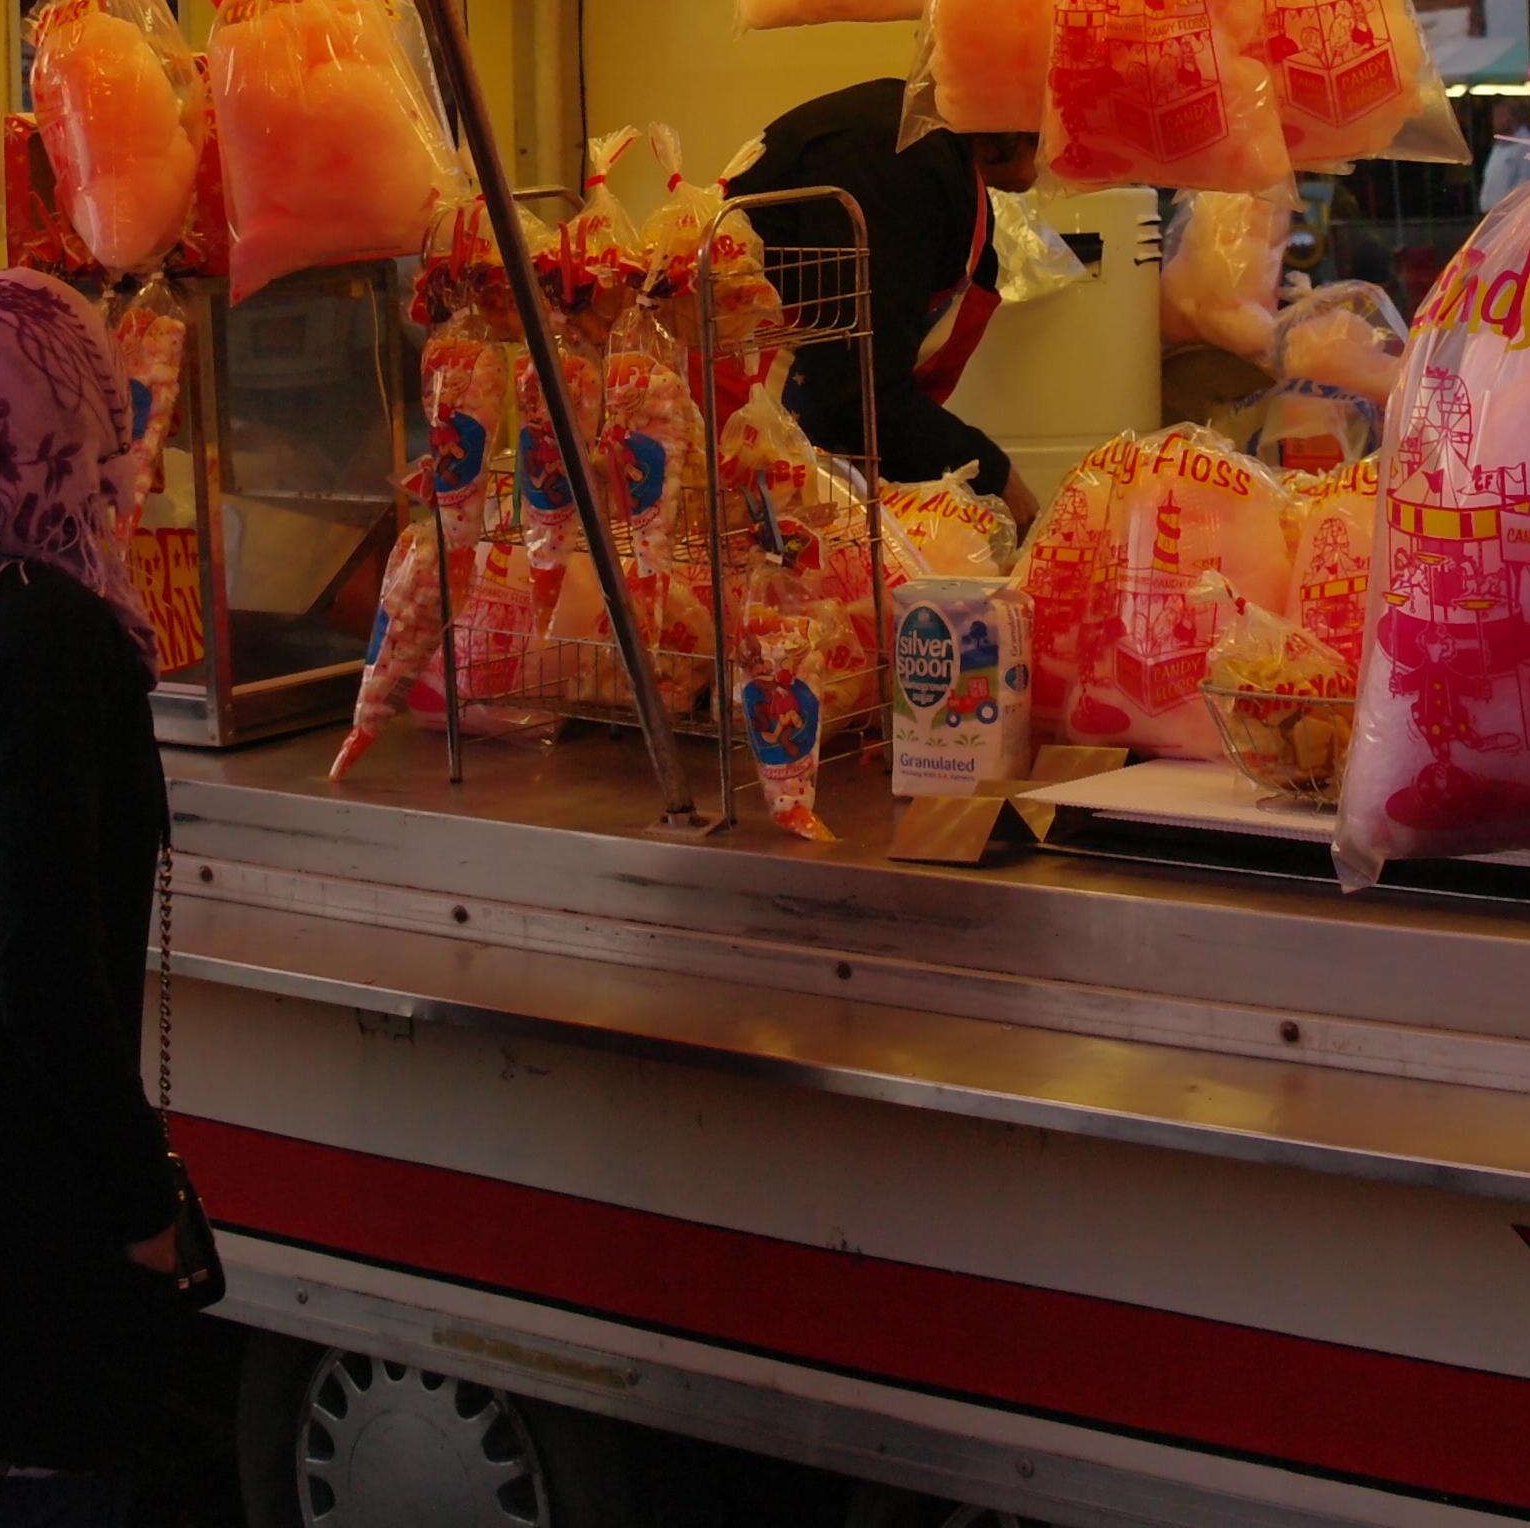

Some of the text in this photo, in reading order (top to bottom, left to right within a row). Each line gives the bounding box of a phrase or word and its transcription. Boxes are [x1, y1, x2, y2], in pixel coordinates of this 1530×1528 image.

[1177, 16, 1207, 32] FLOSS
[1341, 60, 1388, 89] CANDY
[1166, 100, 1215, 130] CANDY
[1152, 433, 1253, 498] Floss
[900, 630, 952, 657] silver
[897, 656, 952, 679] spoon
[1153, 657, 1201, 683] CANDY
[900, 753, 976, 773] Granulated
